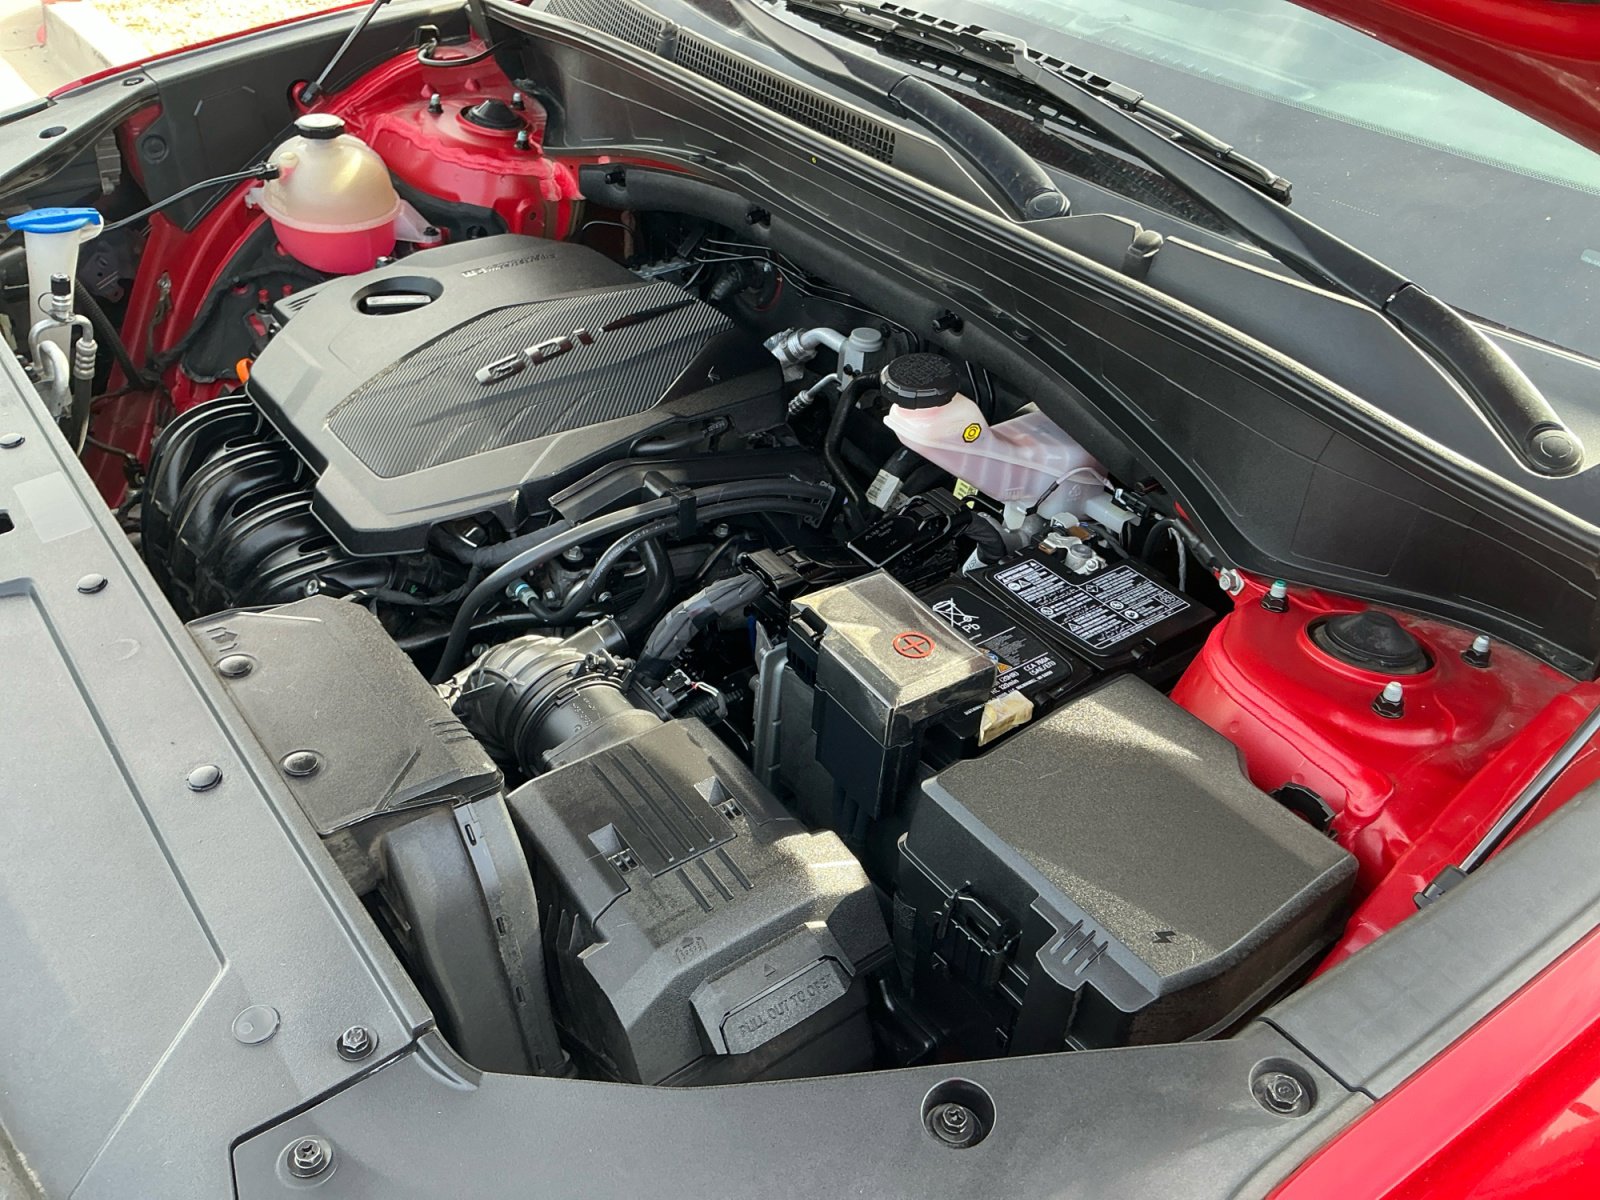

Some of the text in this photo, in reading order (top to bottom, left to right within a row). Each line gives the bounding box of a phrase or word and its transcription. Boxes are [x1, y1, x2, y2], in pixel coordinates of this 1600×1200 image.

[961, 623, 980, 633] Pb
[1023, 663, 1036, 672] CCA
[739, 1015, 767, 1037] PULL
[767, 1000, 789, 1019] OUT
[790, 991, 806, 1007] TO
